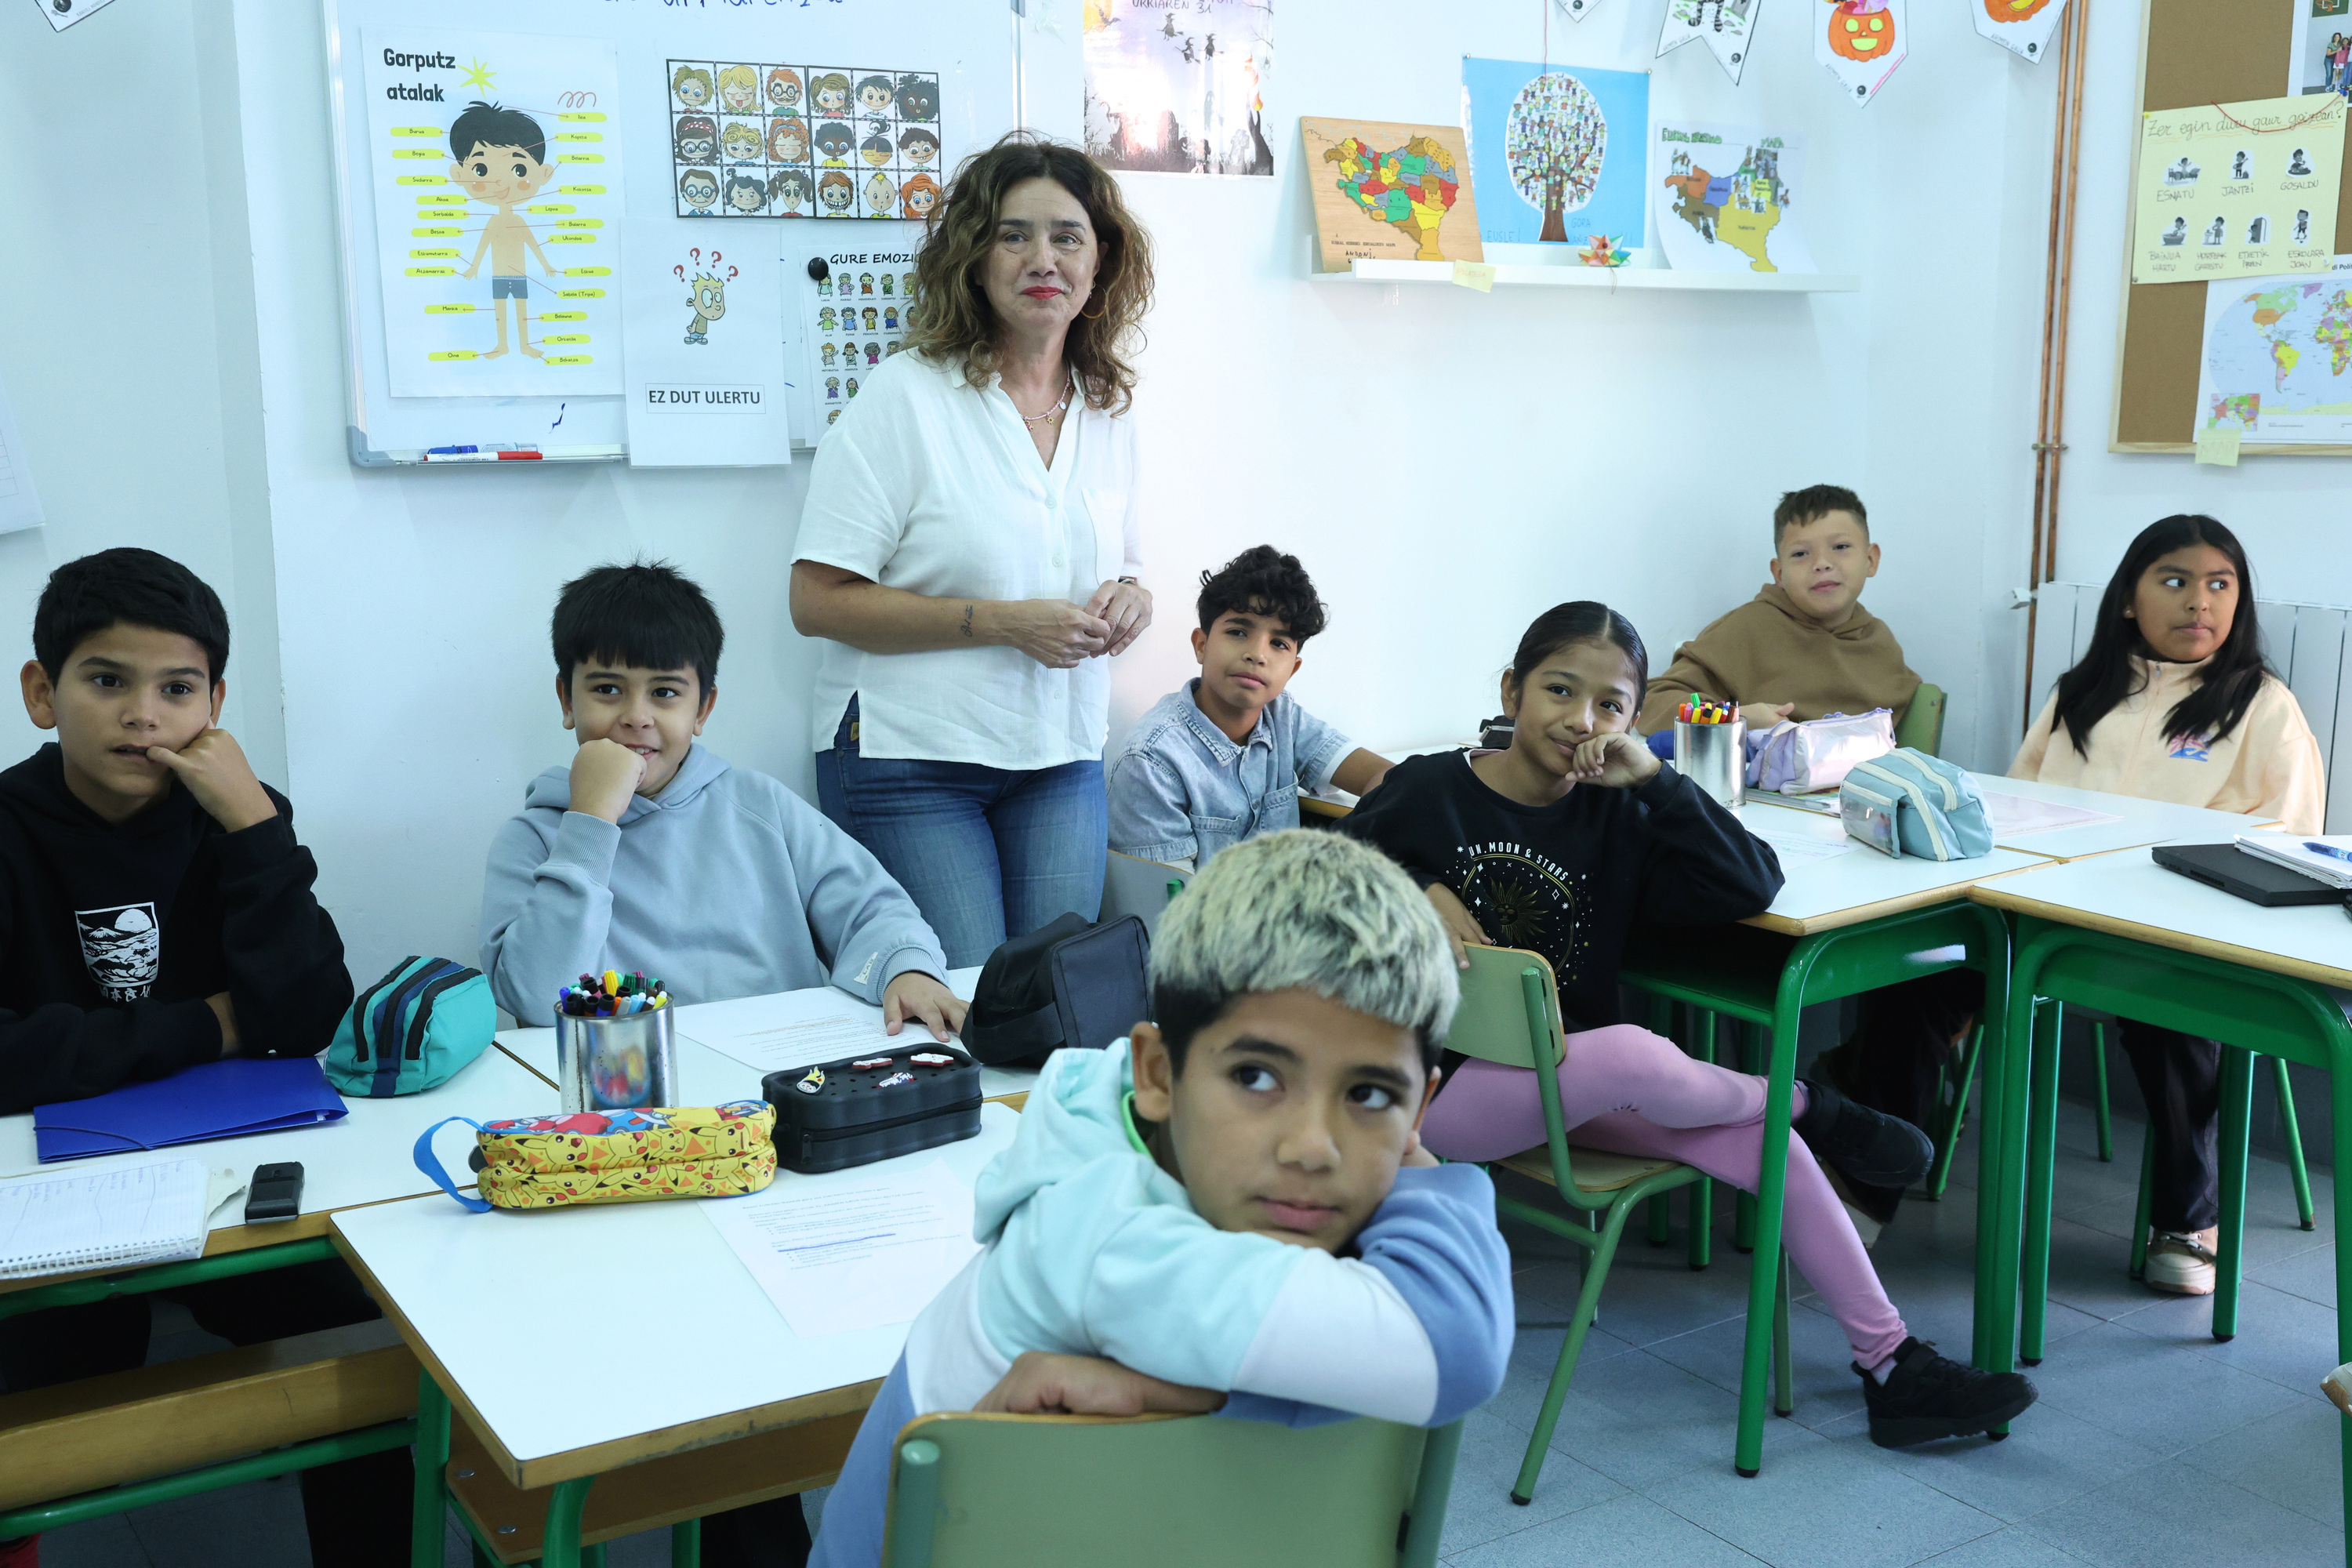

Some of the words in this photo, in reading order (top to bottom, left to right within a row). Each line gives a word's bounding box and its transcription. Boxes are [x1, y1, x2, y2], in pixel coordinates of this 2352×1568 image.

[383, 48, 456, 72] Gorputz
[387, 83, 445, 102] atalak
[2180, 120, 2212, 141] egin
[2281, 180, 2319, 191] GOSALDU
[829, 253, 868, 265] GURE
[873, 252, 914, 263] EMOZI
[649, 390, 666, 403] EZ
[670, 390, 700, 404] DUT
[705, 391, 760, 405] ULERTU
[1489, 842, 1520, 855] MOON
[1525, 848, 1532, 858] &
[1536, 855, 1568, 881] STARS
